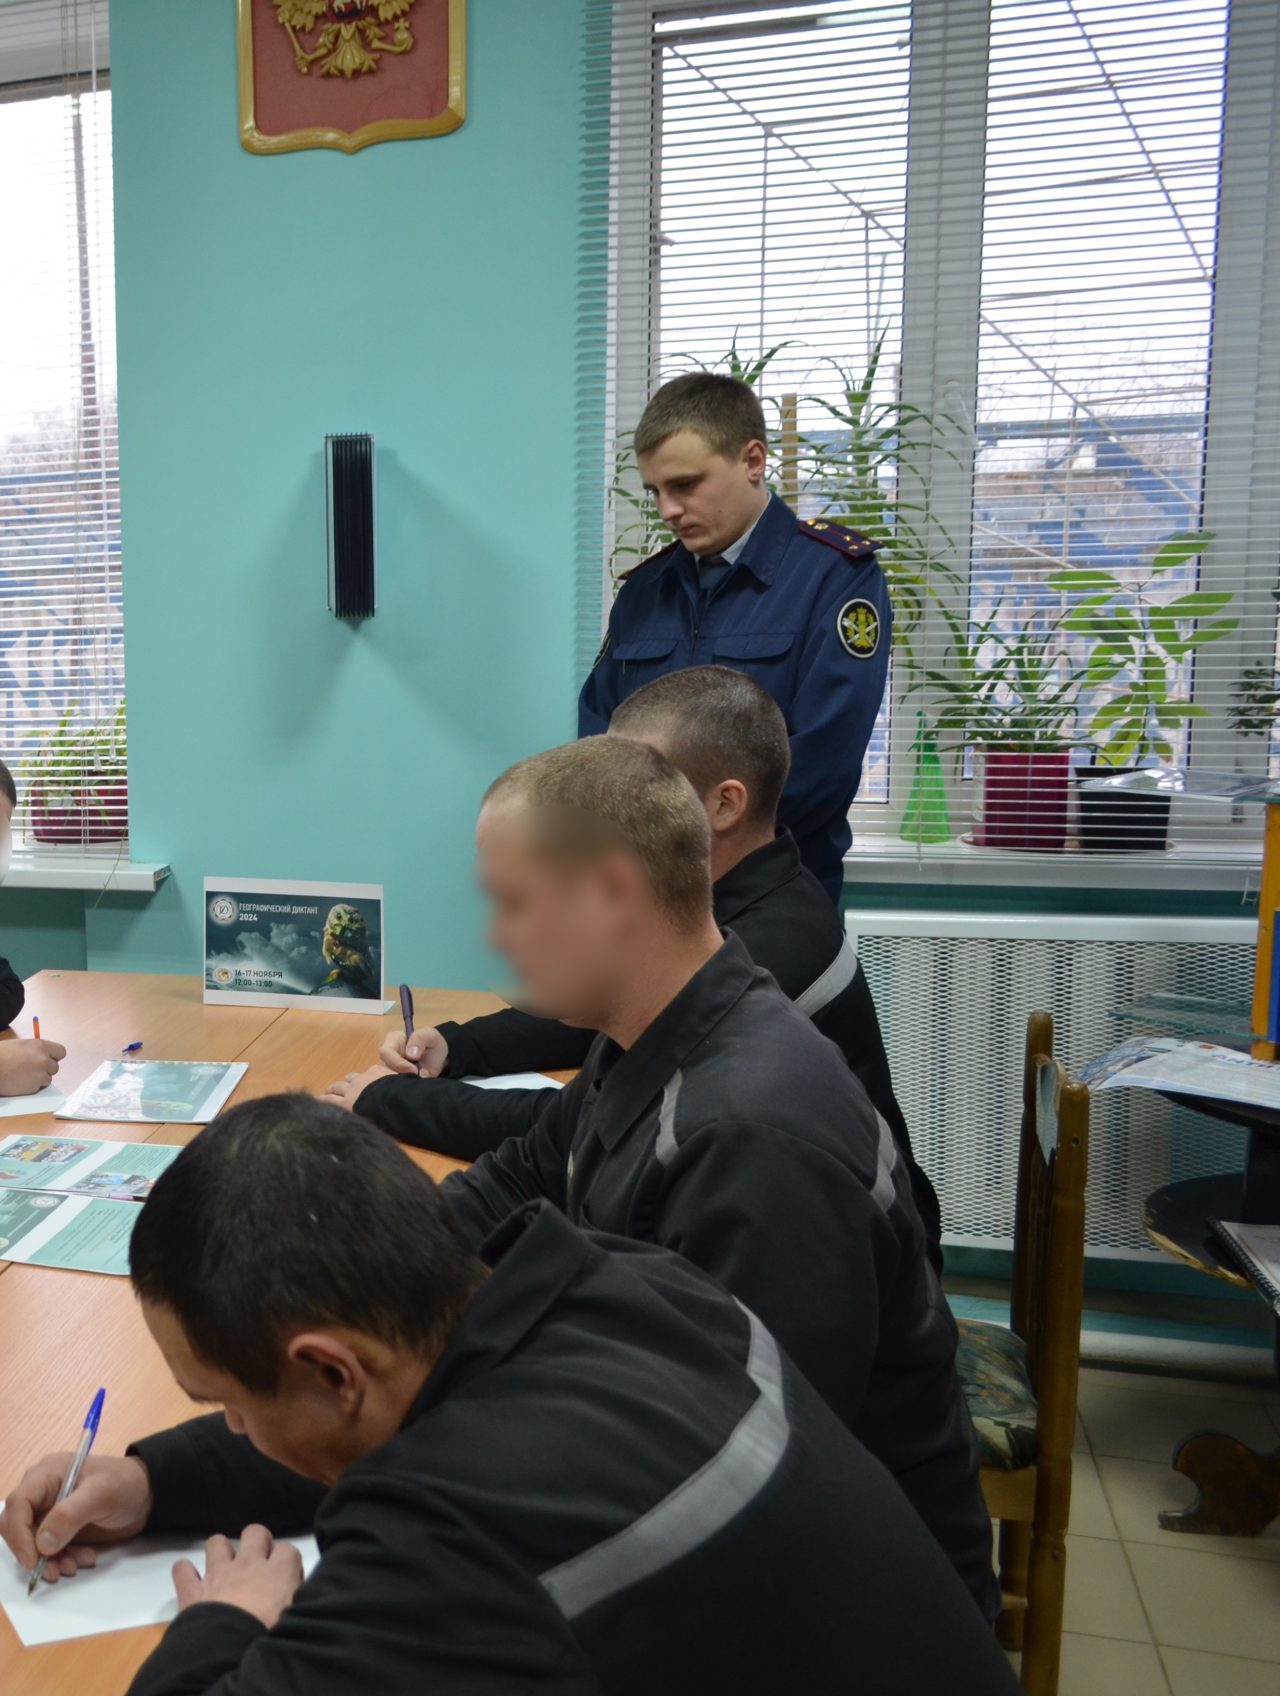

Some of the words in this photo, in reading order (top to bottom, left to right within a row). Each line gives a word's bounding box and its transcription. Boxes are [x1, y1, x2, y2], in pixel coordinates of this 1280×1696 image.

[239, 903, 291, 913] ГЕОГРАФИЧЕСКИЙ
[292, 905, 319, 915] ДИКТАНТ
[239, 913, 258, 921] 2024
[235, 969, 252, 977] 16-17
[253, 970, 283, 979] НОЯБРЯ
